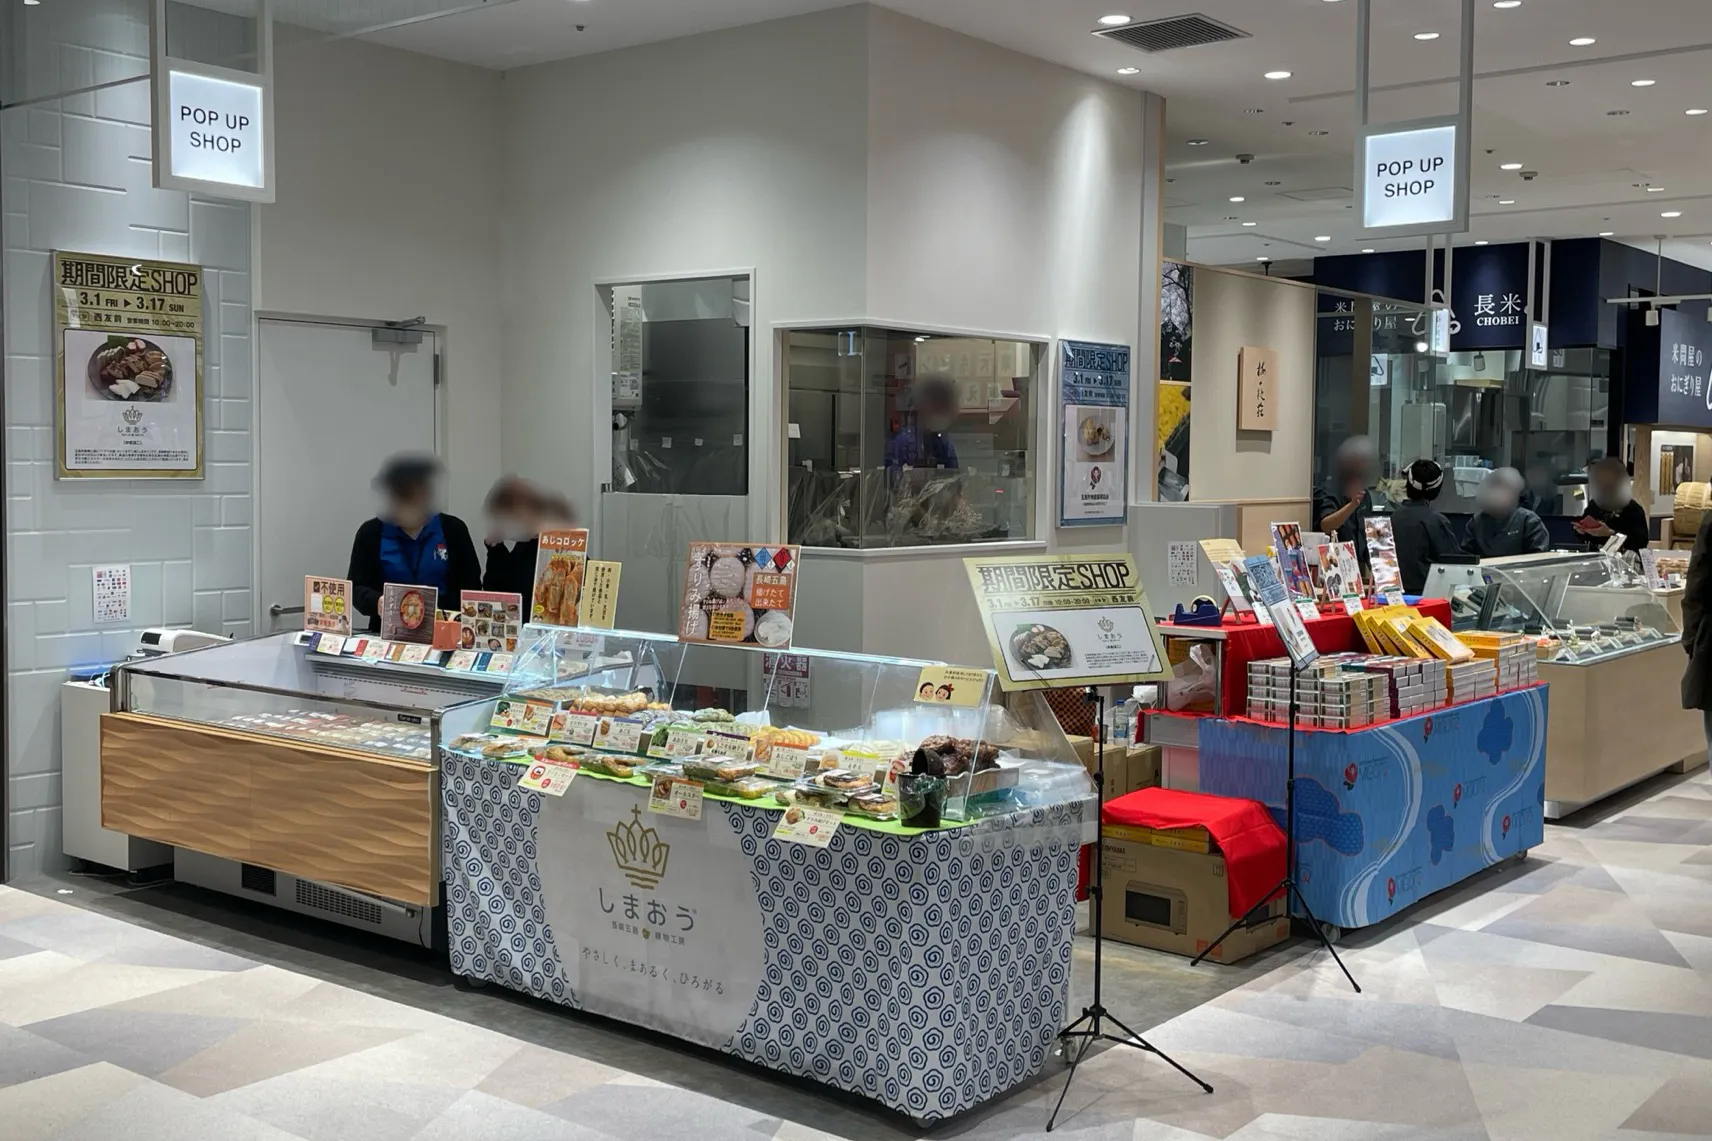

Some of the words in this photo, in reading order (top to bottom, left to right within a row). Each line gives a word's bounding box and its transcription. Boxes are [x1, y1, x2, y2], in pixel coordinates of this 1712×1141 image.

[181, 105, 219, 125] POP
[226, 113, 249, 130] UP
[190, 131, 241, 153] SHOP
[1376, 160, 1413, 177] POP
[1420, 157, 1444, 173] UP
[1384, 180, 1434, 198] SHOP
[61, 260, 198, 295] 期間限定SHOP
[80, 292, 101, 306] 3.1
[105, 298, 119, 307] FRI
[136, 296, 165, 311] 3.17
[169, 304, 184, 312] SUN
[1474, 293, 1521, 316] 長米
[1333, 316, 1397, 332] おにり屋
[1476, 316, 1520, 326] CHOBEI
[541, 535, 585, 547] あじコロッケ
[979, 562, 1130, 594] 期間限定SHOP
[599, 887, 694, 931] しまおう
